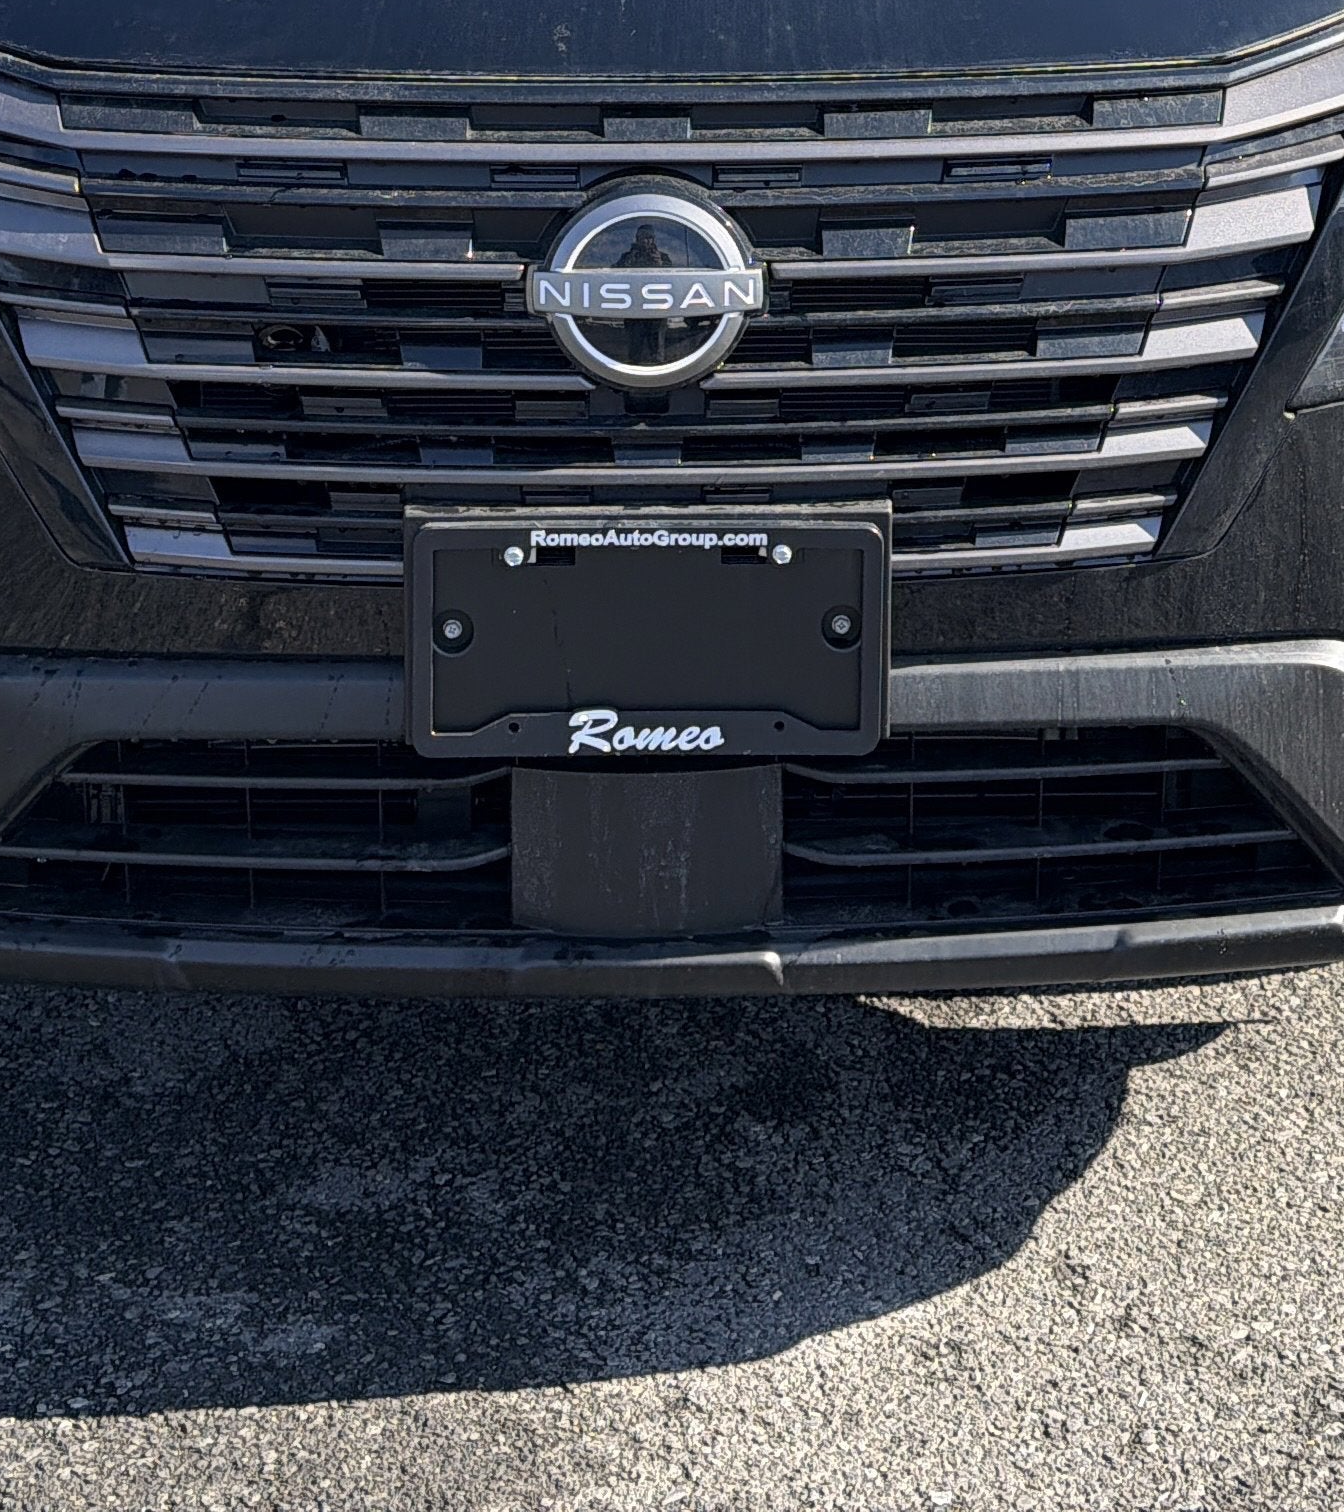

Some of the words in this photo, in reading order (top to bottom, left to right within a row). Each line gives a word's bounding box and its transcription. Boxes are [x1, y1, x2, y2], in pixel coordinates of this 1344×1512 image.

[539, 278, 755, 310] NISSAN
[530, 529, 768, 549] RomeoAutoGroup.com
[568, 709, 725, 754] Romeo
